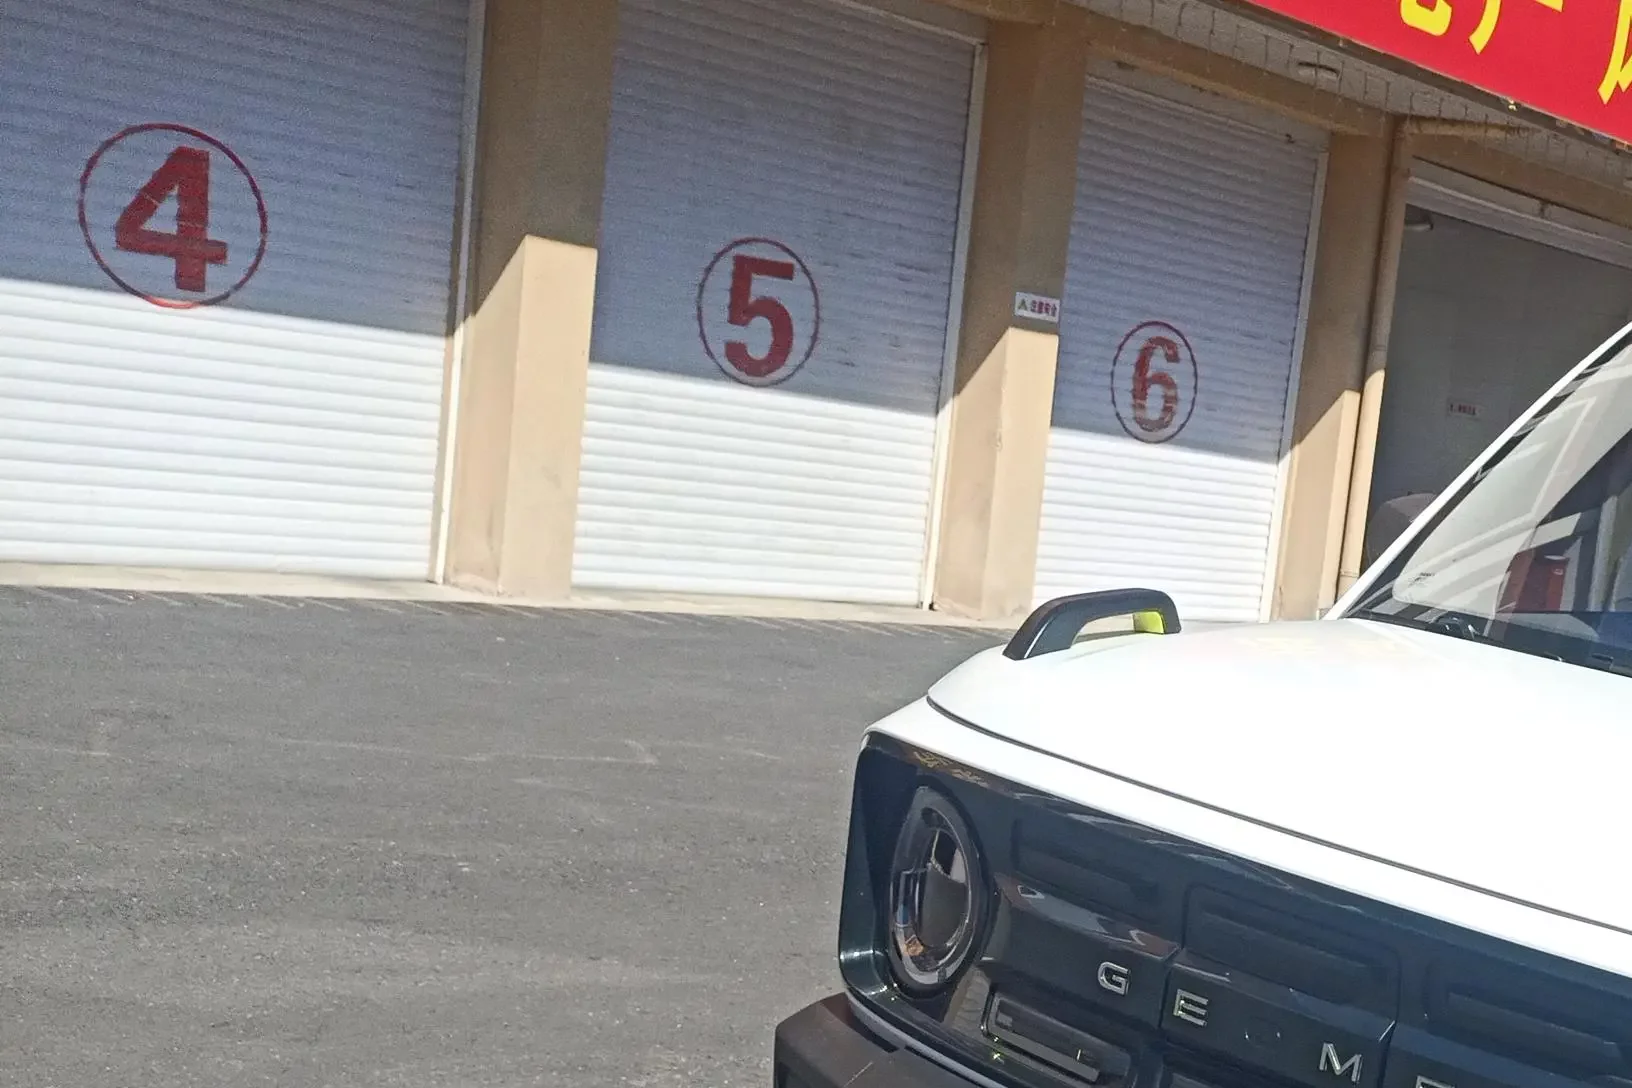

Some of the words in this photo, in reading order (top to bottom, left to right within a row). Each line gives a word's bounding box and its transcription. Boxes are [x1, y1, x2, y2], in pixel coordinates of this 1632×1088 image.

[115, 145, 228, 293] 4
[724, 254, 796, 378] 5
[1132, 337, 1179, 433] 6
